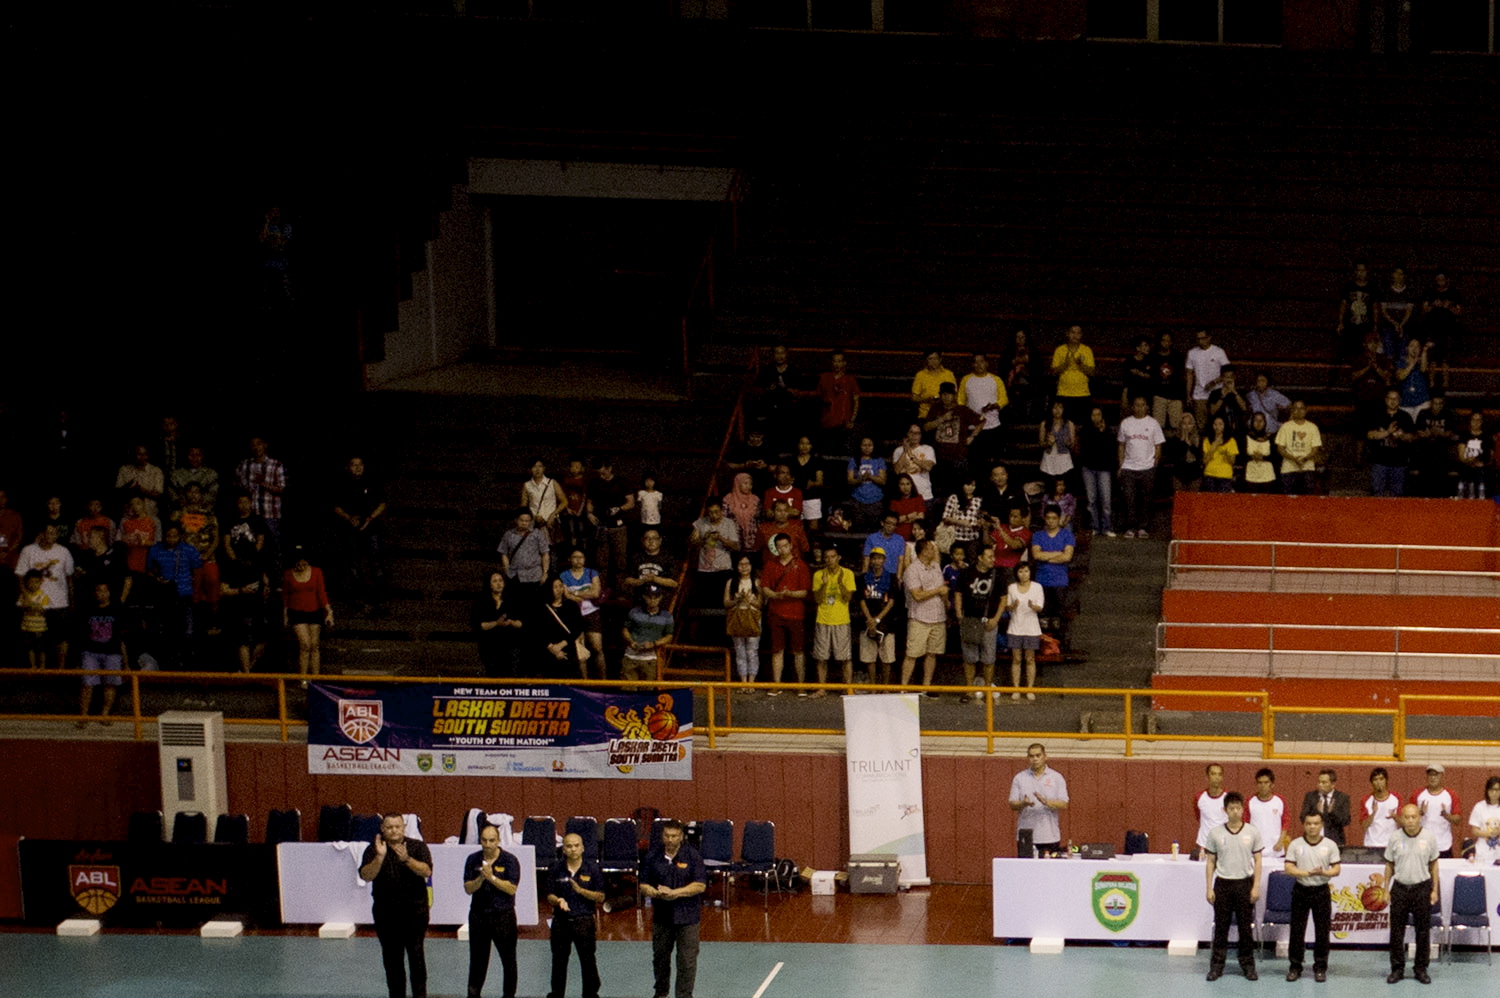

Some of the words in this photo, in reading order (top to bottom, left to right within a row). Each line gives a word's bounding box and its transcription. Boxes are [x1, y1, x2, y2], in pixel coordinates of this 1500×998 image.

[453, 688, 473, 696] NEW
[475, 688, 498, 697] TEAM
[499, 688, 514, 697] ON
[514, 689, 531, 697] THE
[531, 689, 550, 697] RISE
[345, 706, 378, 719] ABL
[432, 700, 506, 718] LASKAR
[509, 701, 571, 719] DREYA
[432, 719, 488, 735] SOUTH
[489, 720, 571, 736] SUMATRA
[485, 738, 498, 746] OF
[499, 738, 516, 746] THE
[323, 747, 401, 761] ASEAN
[851, 759, 912, 773] TRILIANT
[75, 871, 118, 887] ABL
[129, 877, 228, 895] ASEAN
